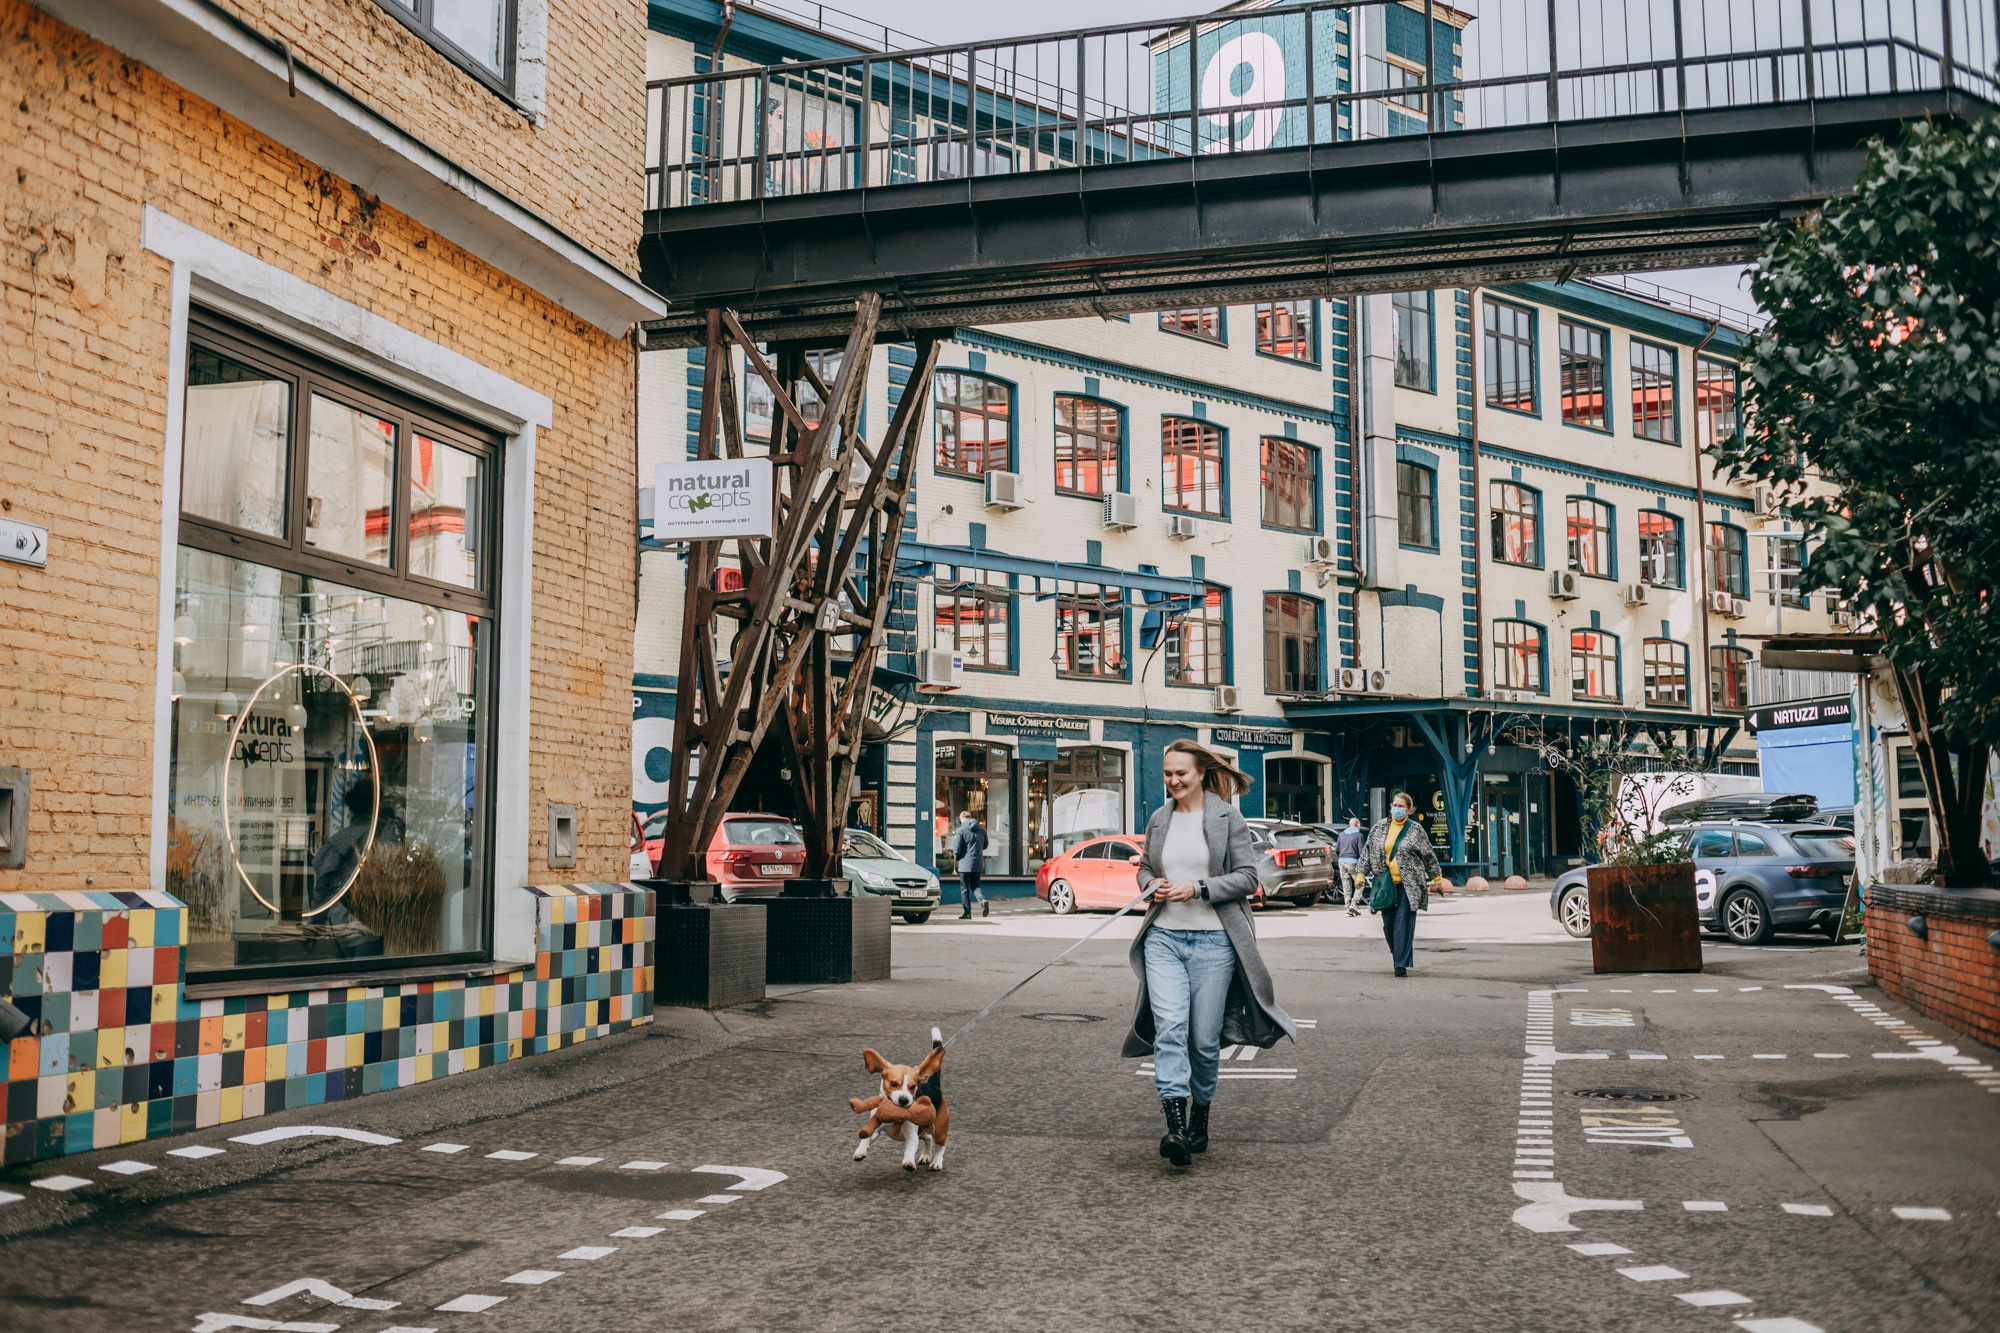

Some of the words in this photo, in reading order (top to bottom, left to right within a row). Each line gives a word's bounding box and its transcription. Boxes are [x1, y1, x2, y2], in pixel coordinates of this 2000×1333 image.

[1201, 32, 1286, 155] 9
[669, 469, 750, 491] natural
[989, 714, 1017, 726] VISUAL
[1017, 715, 1055, 728] COMFORT
[1055, 718, 1089, 731] GALLERY
[1773, 706, 1818, 725] NATUZZI
[1824, 704, 1850, 717] ITALIA
[1579, 1106, 1695, 1148] 1207
